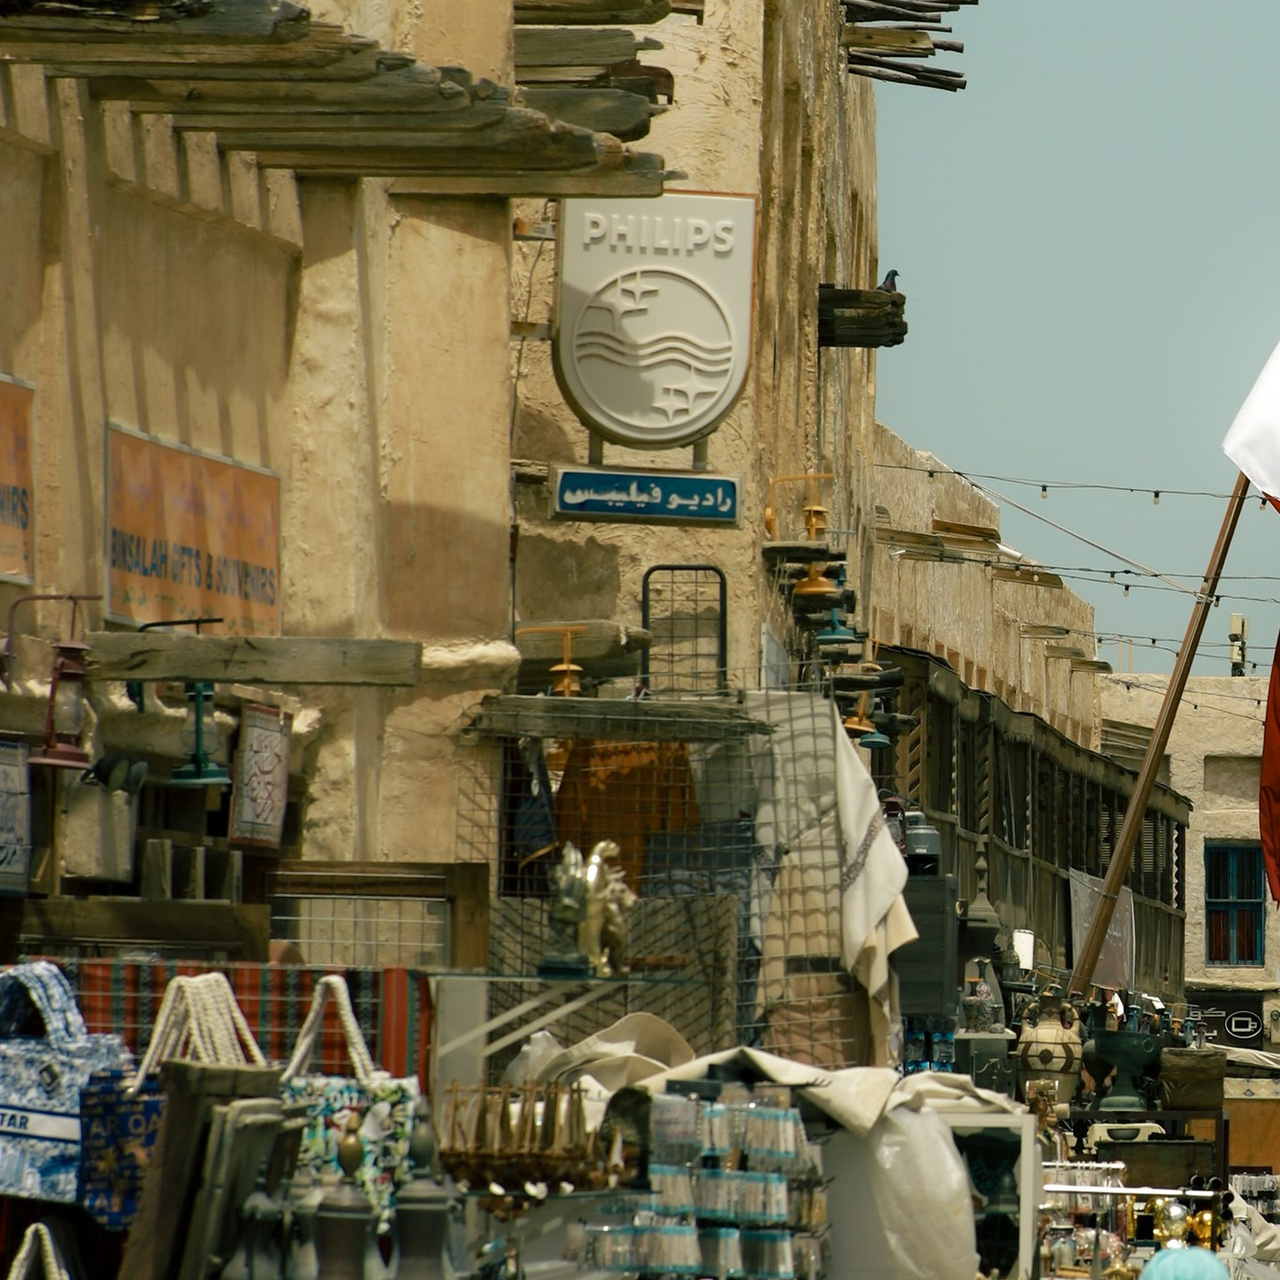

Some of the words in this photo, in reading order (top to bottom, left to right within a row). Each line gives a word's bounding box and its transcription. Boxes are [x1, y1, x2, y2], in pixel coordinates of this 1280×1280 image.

[584, 213, 735, 253] PHILIPS
[667, 487, 732, 512] راديو
[112, 528, 168, 580] BINSALAH
[205, 553, 213, 591] &
[215, 556, 276, 607] SOUVENIRS
